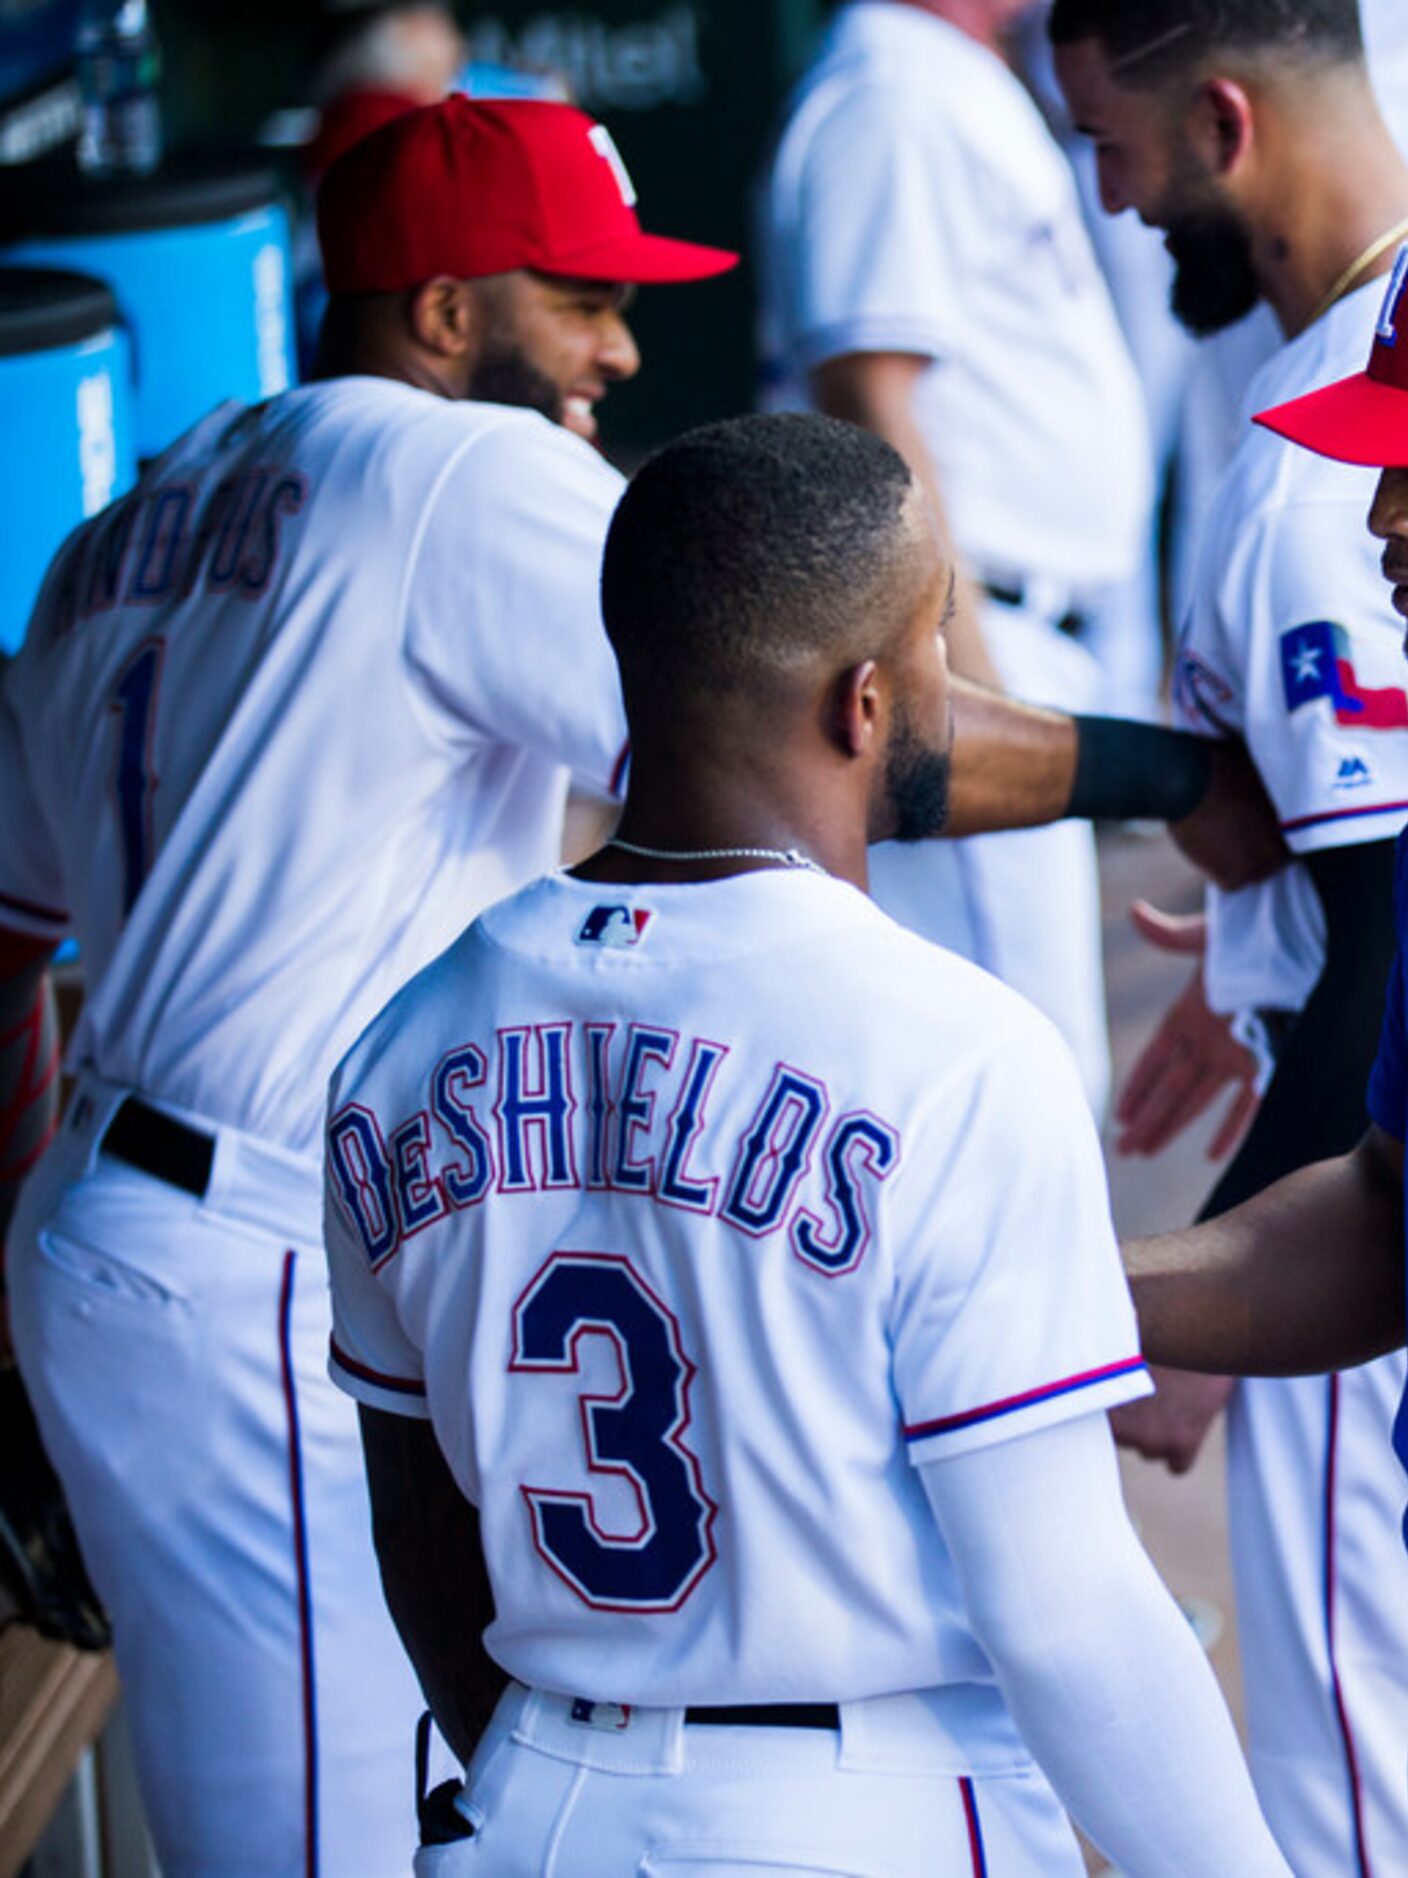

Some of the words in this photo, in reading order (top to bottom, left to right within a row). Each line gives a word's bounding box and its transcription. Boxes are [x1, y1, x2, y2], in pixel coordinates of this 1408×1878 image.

[108, 634, 168, 930] 1
[328, 1021, 901, 1278] DeSHIELDS
[508, 1250, 718, 1614] 3
